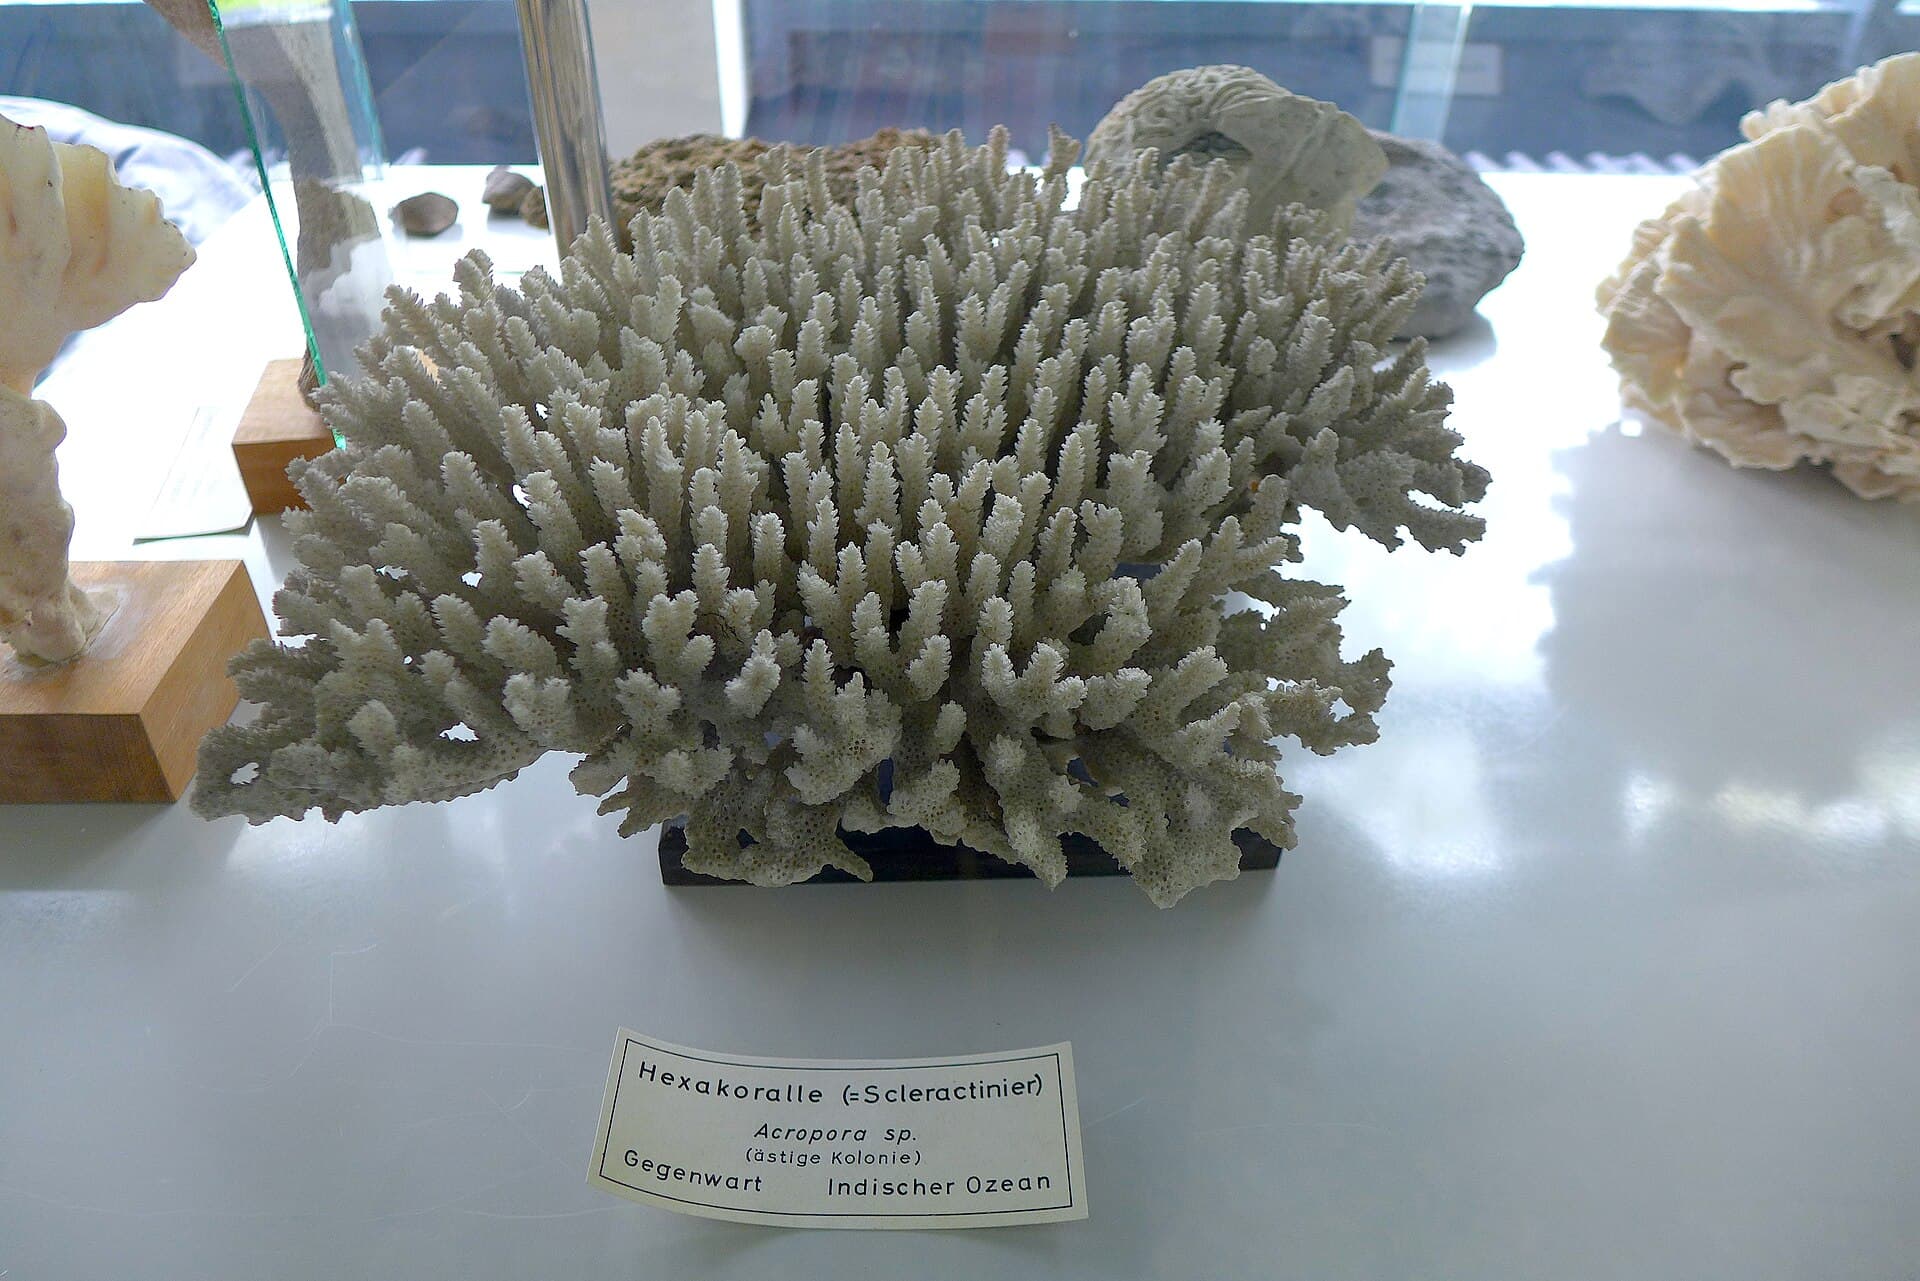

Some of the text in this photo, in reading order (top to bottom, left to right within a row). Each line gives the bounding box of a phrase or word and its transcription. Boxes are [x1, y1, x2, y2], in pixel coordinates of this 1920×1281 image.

[638, 1060, 1043, 1107] Hexakoralle (=Scleractinier)
[753, 1122, 917, 1146] Acropora sp.
[745, 1147, 921, 1168] (ästige Kolonie)
[624, 1149, 762, 1193] Gegenwart
[828, 1175, 1051, 1196] Indischer Ozean
